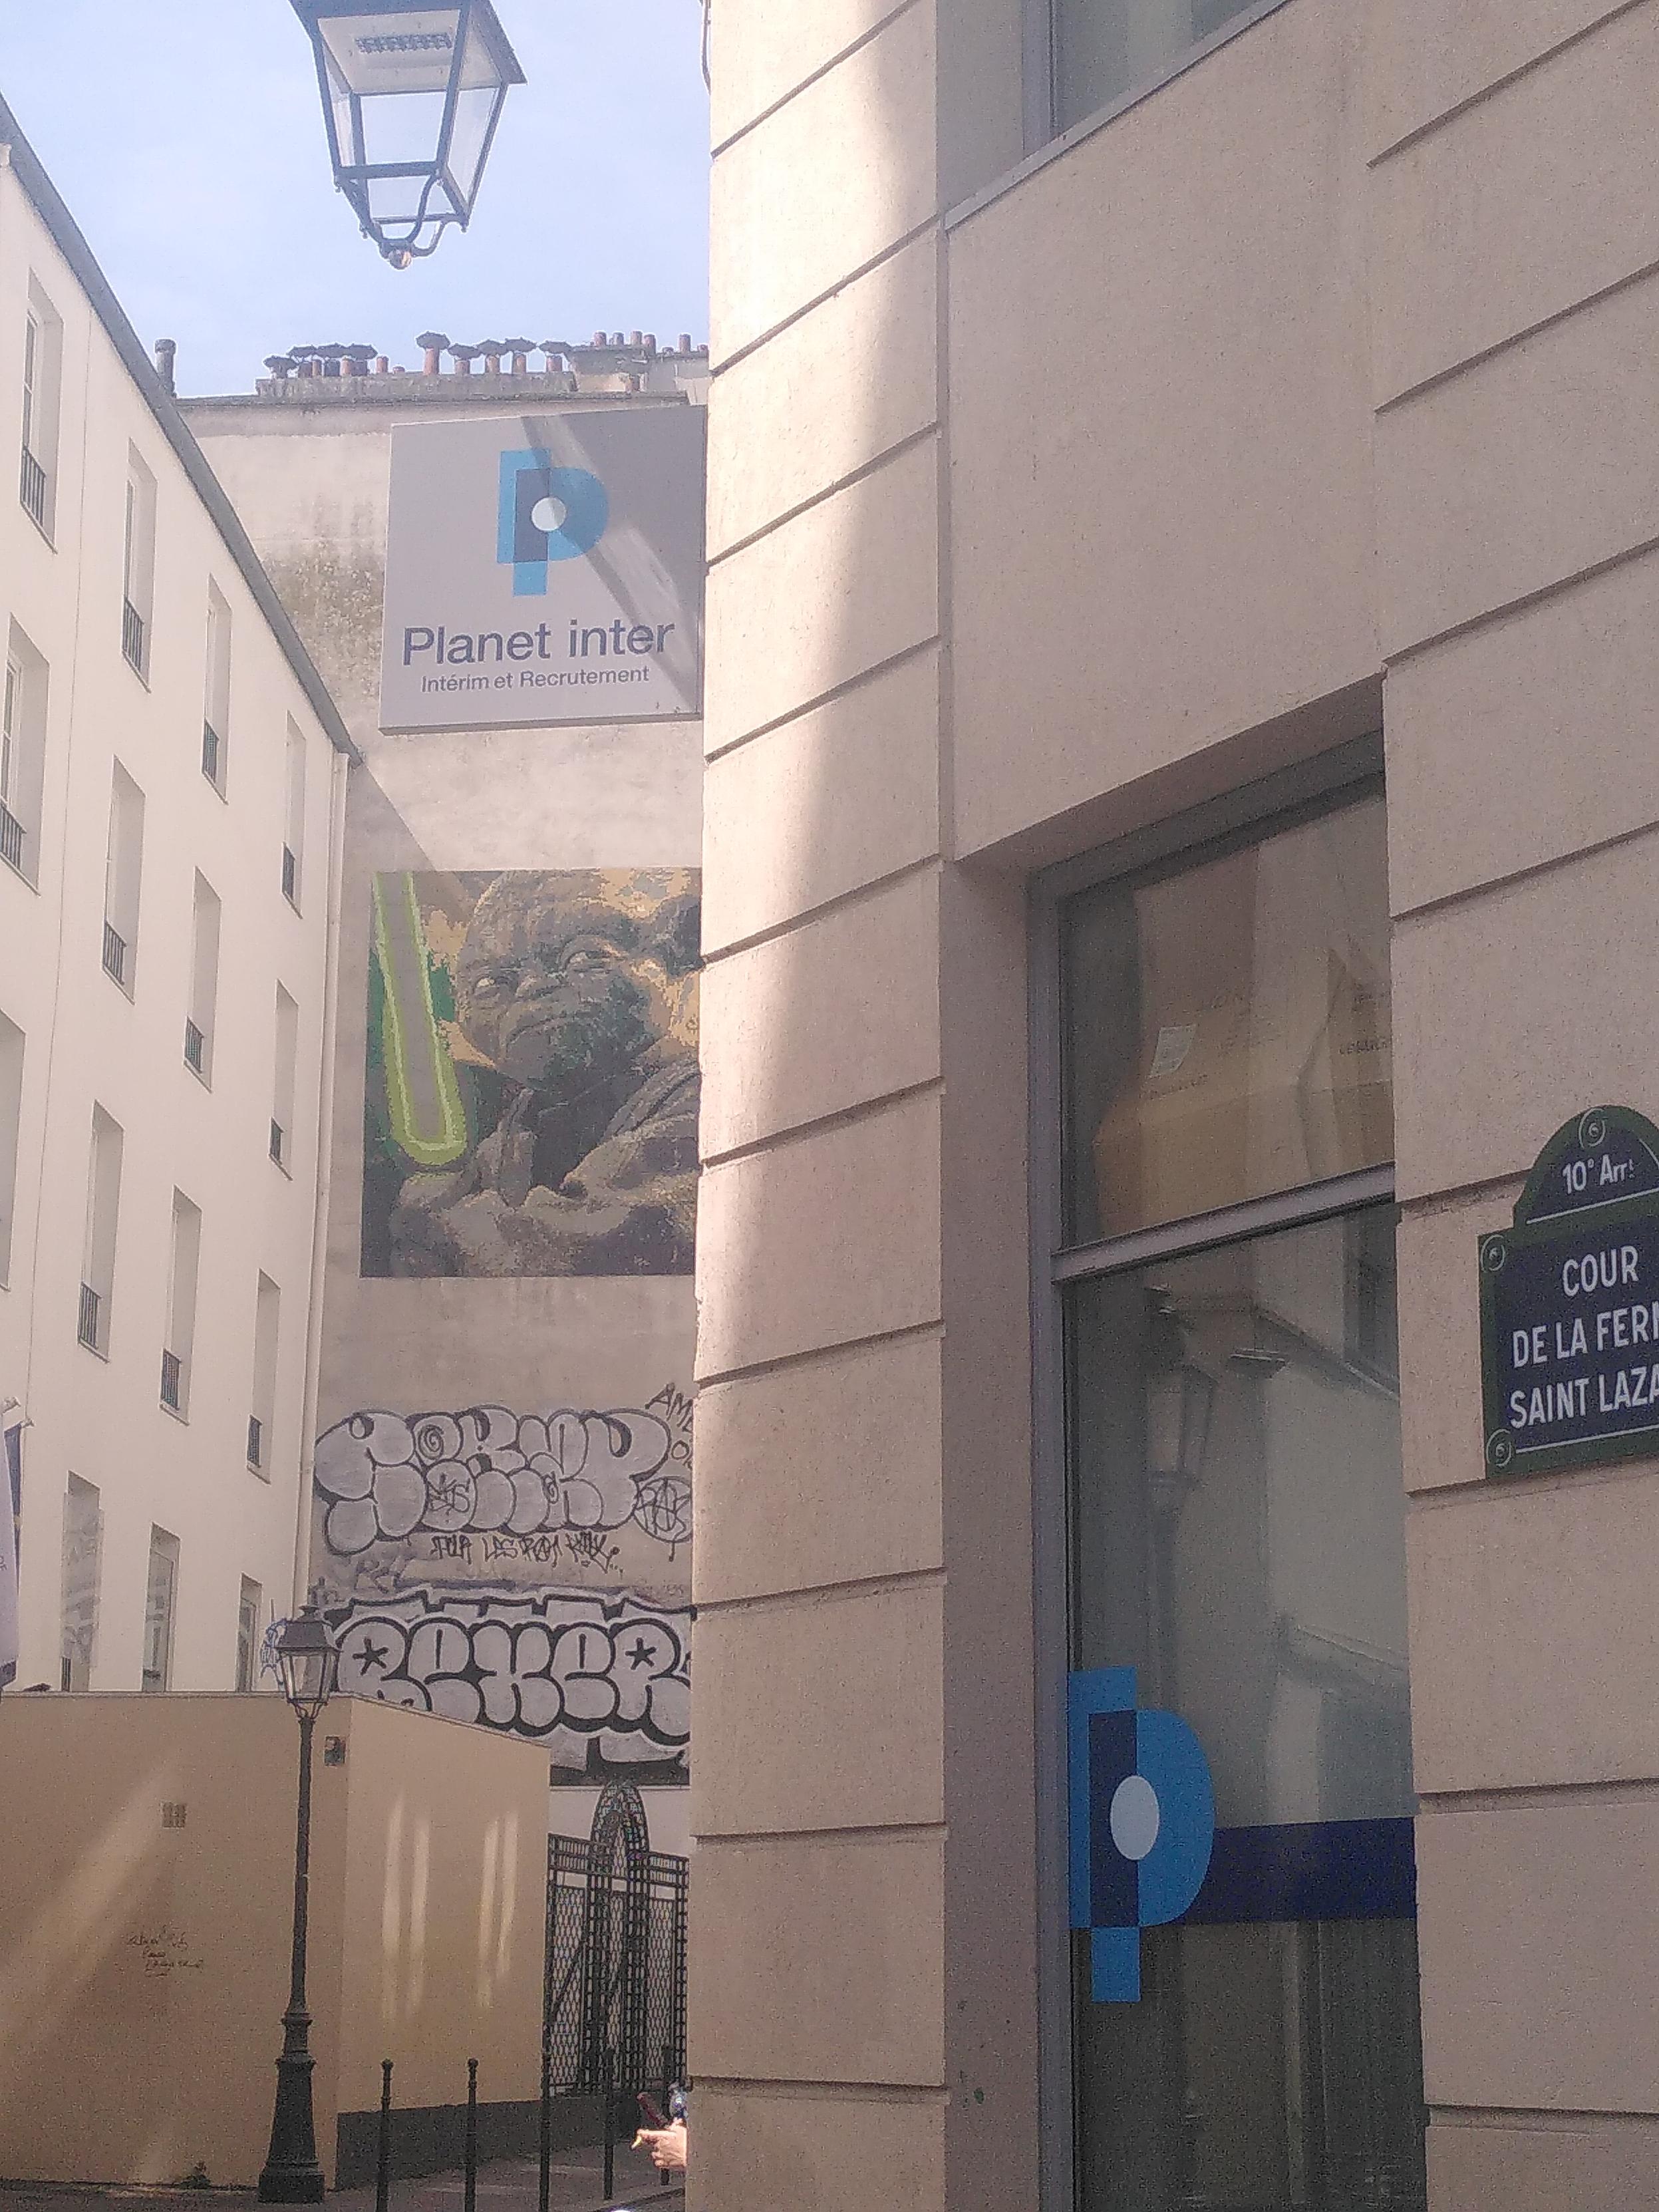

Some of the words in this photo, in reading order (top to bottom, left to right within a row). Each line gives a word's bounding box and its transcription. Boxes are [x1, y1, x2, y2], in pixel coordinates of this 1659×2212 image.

[402, 623, 551, 665] Planet
[569, 619, 676, 657] inter
[420, 671, 490, 693] Intérim
[494, 672, 514, 690] et
[519, 666, 651, 688] Recrutement
[1563, 1245, 1640, 1297] COUR
[1513, 1325, 1548, 1368] DE
[1555, 1318, 1588, 1359] LA
[1510, 1378, 1590, 1428] SAINT
